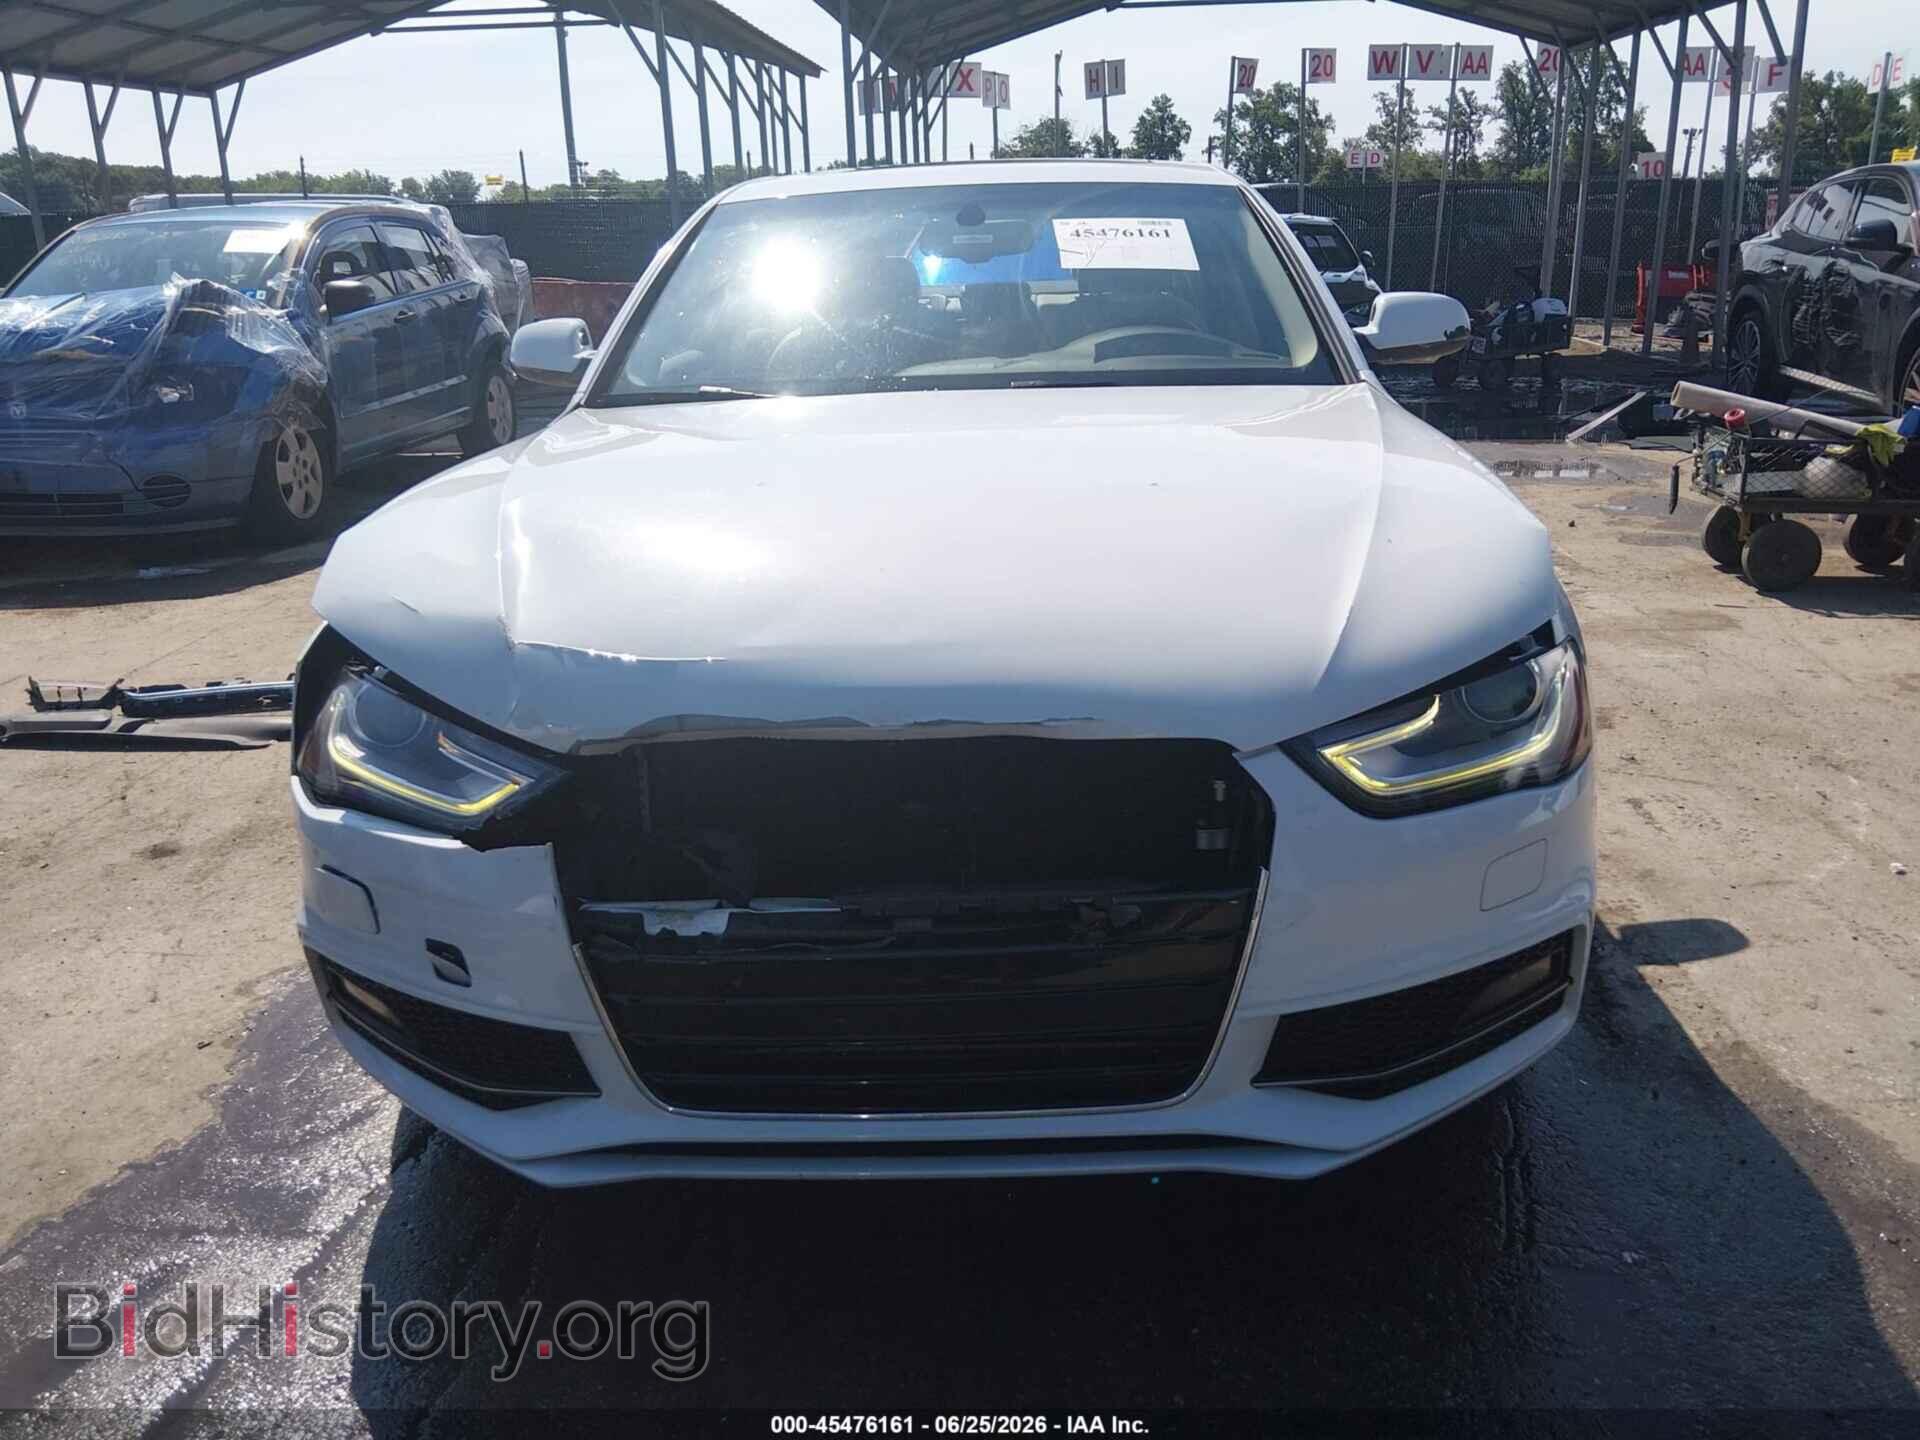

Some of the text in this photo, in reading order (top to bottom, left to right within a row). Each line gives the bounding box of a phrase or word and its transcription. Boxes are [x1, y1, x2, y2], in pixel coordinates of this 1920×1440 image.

[1311, 54, 1334, 77] 20
[1372, 51, 1397, 74] W
[1416, 50, 1435, 73] V
[1461, 52, 1489, 75] AA
[1893, 58, 1904, 81] E
[957, 68, 974, 92] X
[1088, 68, 1100, 92] H
[1238, 64, 1256, 88] 20
[1768, 64, 1786, 86] F
[1351, 153, 1381, 165] E D
[1641, 159, 1665, 178] 10
[1070, 227, 1171, 239] 45476161
